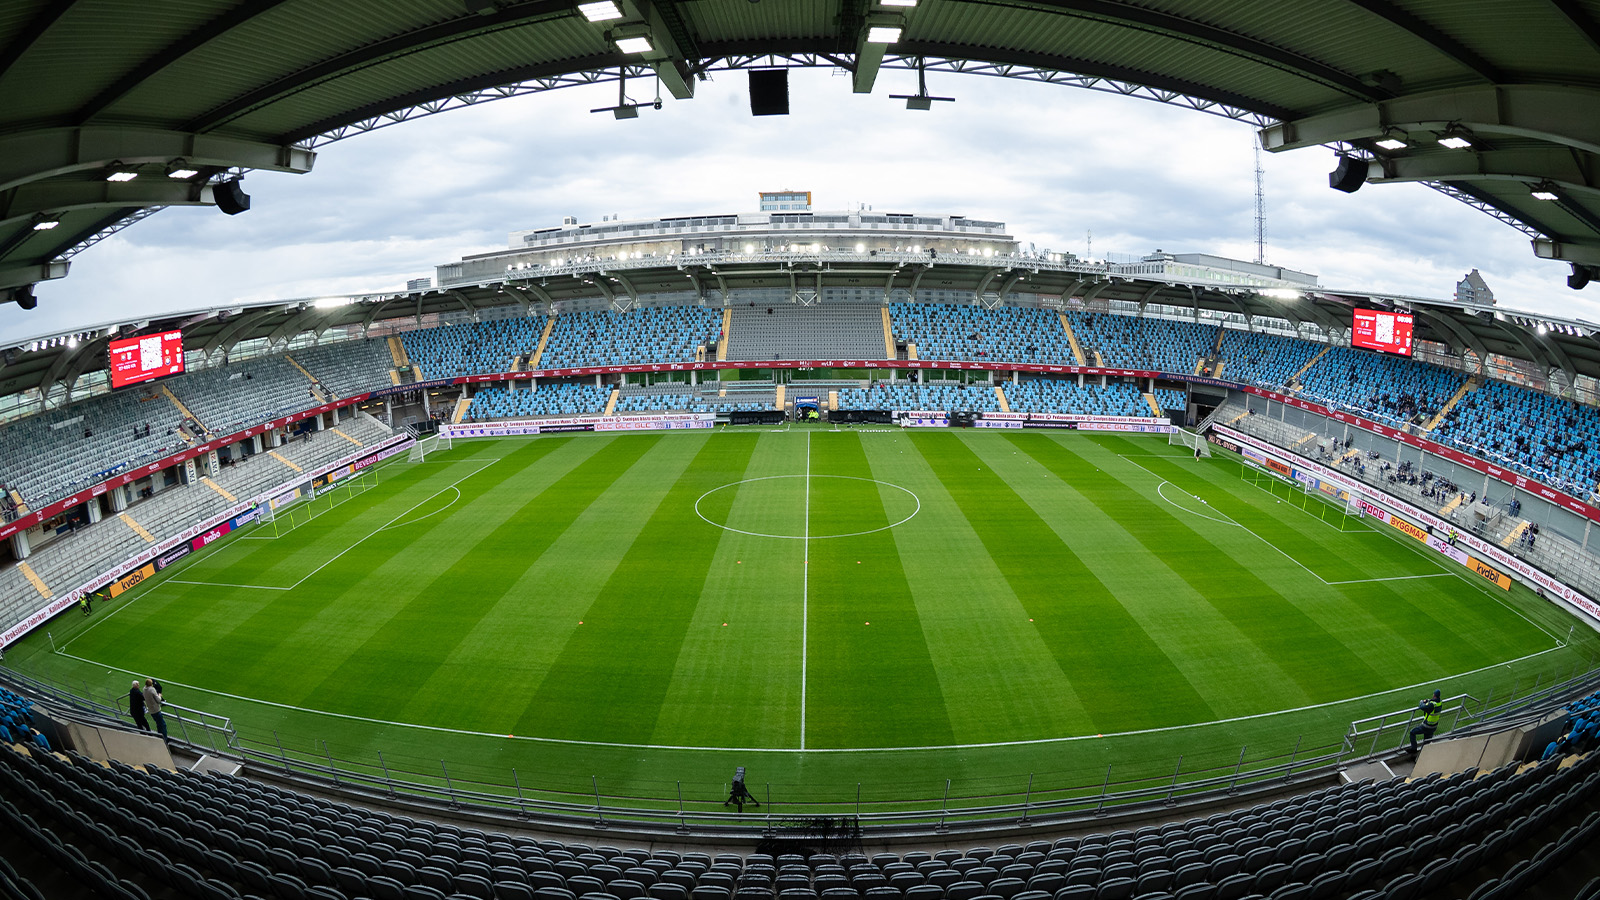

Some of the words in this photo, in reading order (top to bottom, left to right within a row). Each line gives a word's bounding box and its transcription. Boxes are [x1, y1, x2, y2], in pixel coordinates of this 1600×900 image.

[1391, 516, 1426, 540] BYGGMAX
[121, 570, 144, 590] kvdbil
[1476, 563, 1500, 583] kvdbil
[28, 611, 46, 627] Fabriker
